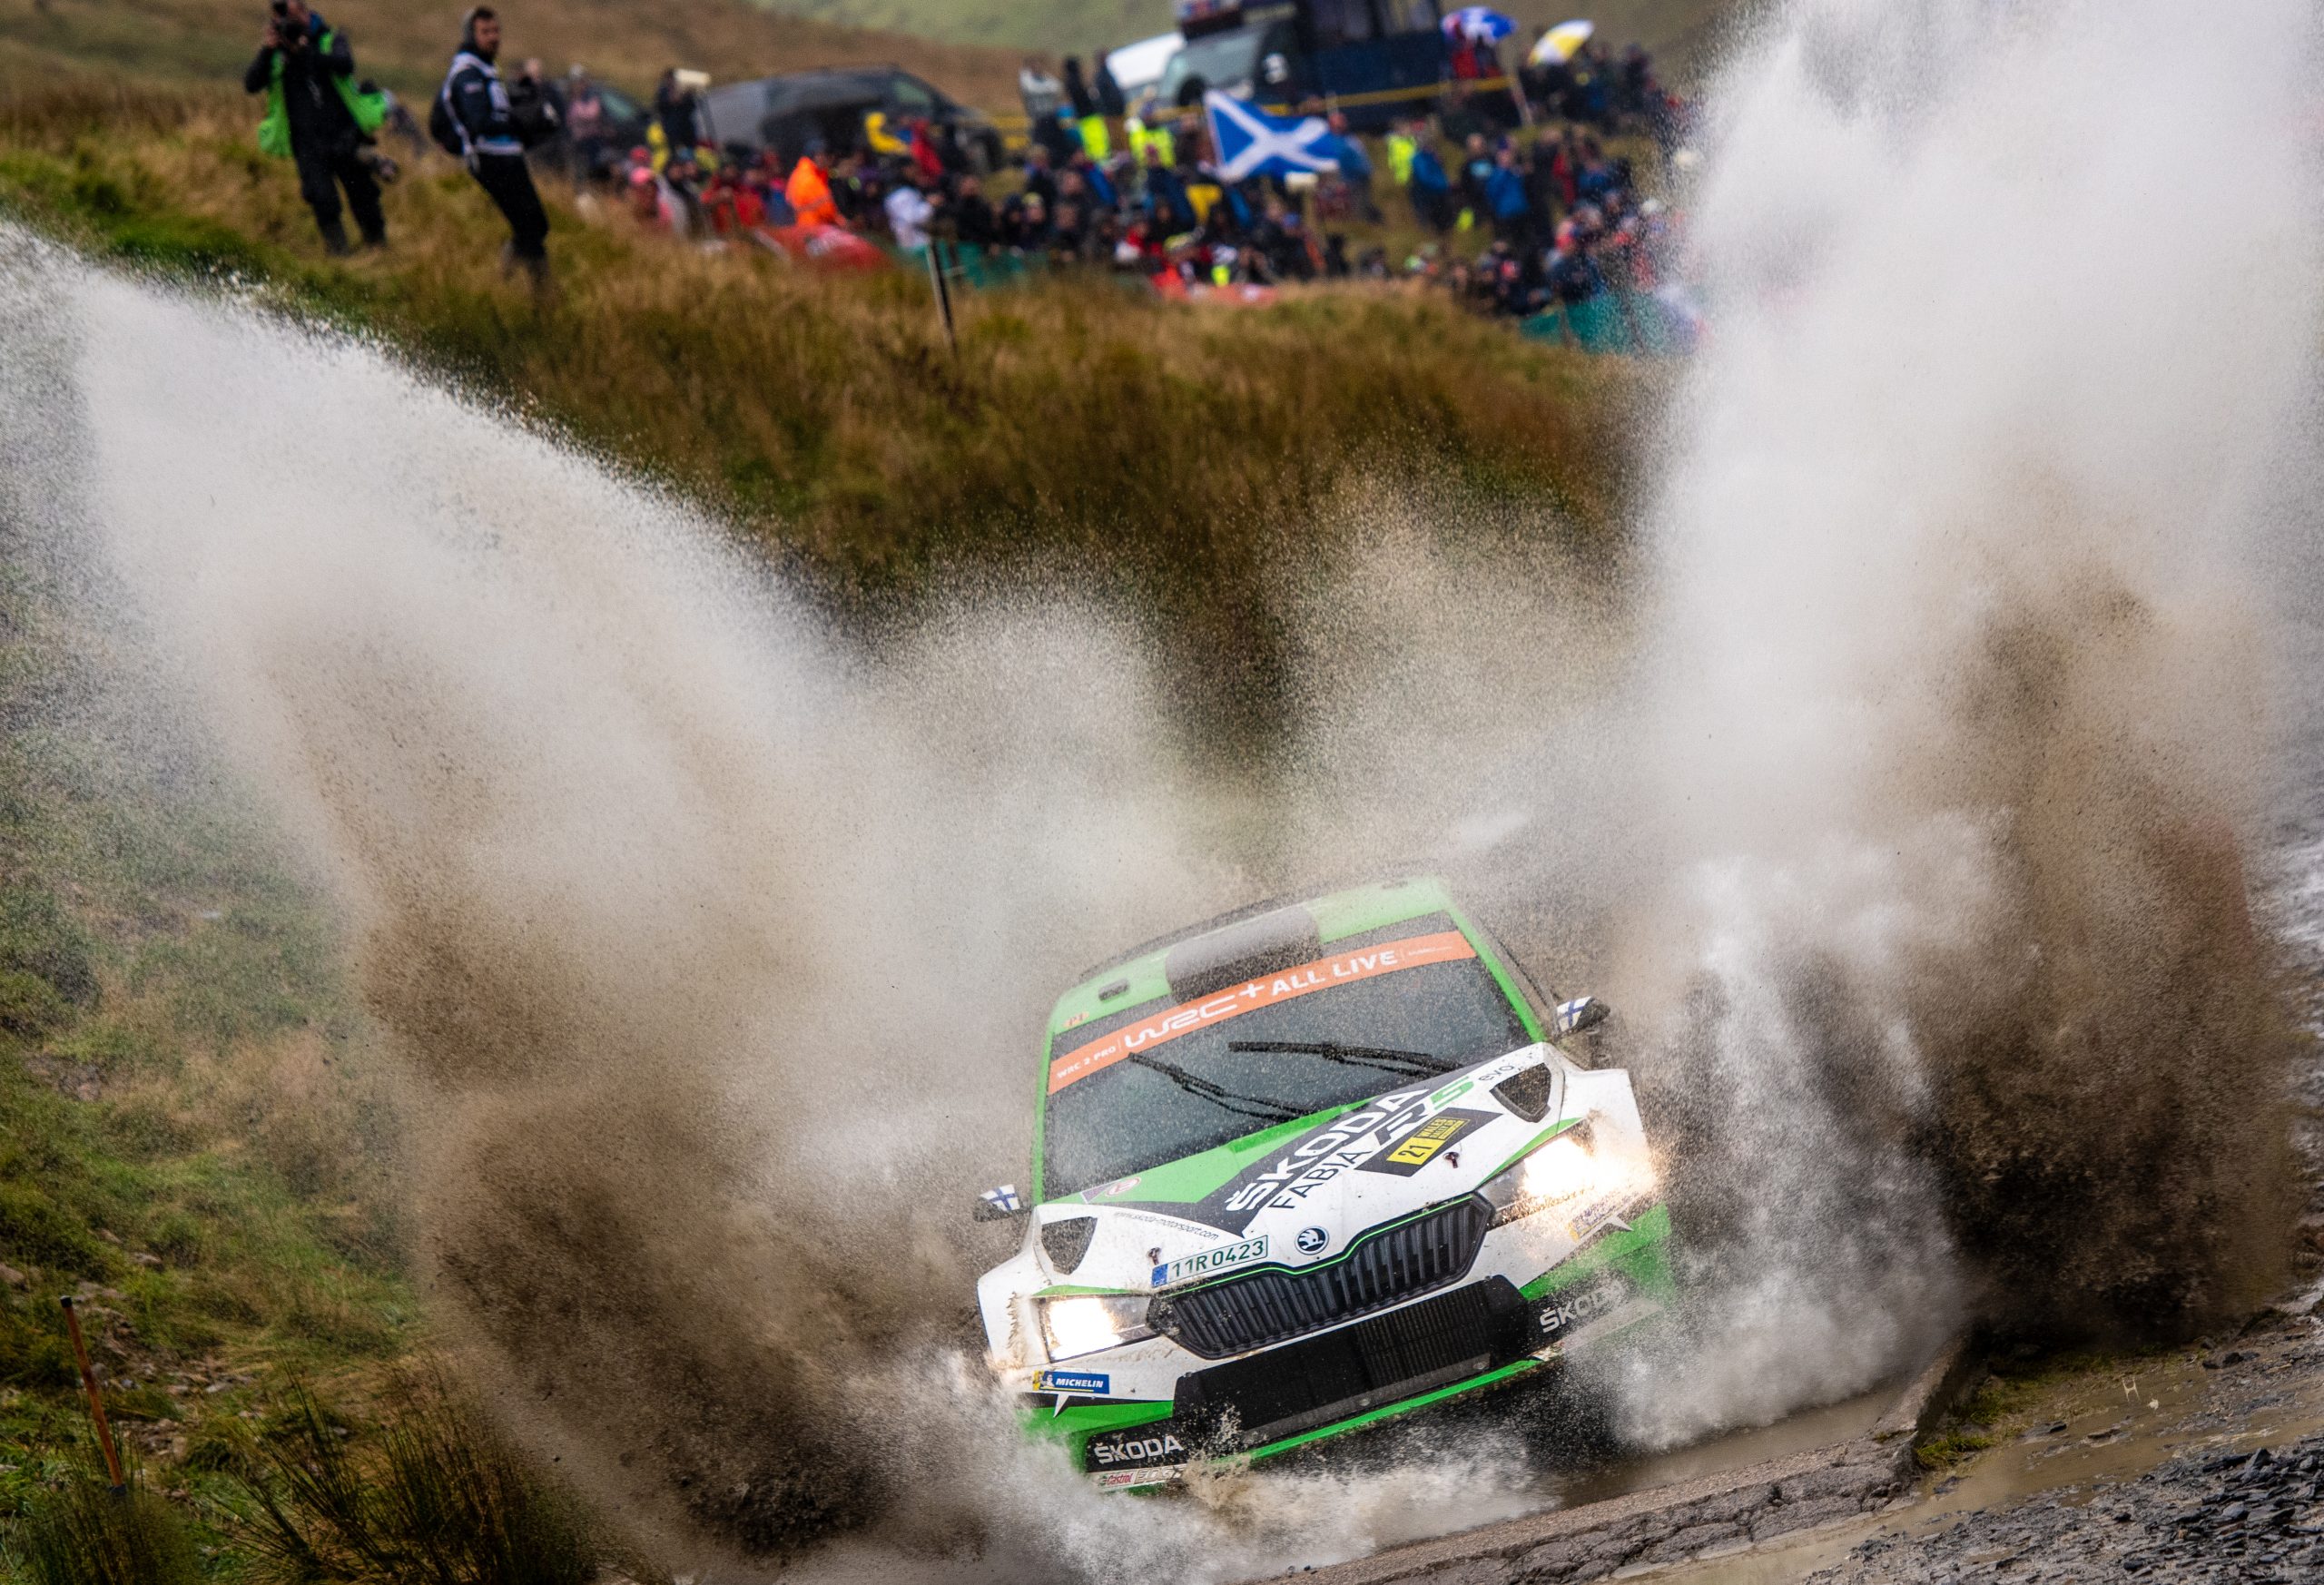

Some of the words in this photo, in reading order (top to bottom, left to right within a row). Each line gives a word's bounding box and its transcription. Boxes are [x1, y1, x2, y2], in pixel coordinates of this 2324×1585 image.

[1271, 970, 1325, 997] ALL
[1332, 950, 1399, 978] LIVE
[1056, 1062, 1081, 1079] WRC
[1083, 1057, 1091, 1066] 2
[1093, 1045, 1117, 1061] PRO
[1226, 1089, 1432, 1211] ŠKODA
[1267, 1150, 1373, 1210] FABIA
[1374, 1075, 1475, 1147] R5
[1478, 1064, 1515, 1082] evo
[1397, 1144, 1433, 1158] 21
[1055, 1377, 1104, 1388] MICHELIN
[1093, 1433, 1184, 1465] ŠKODA
